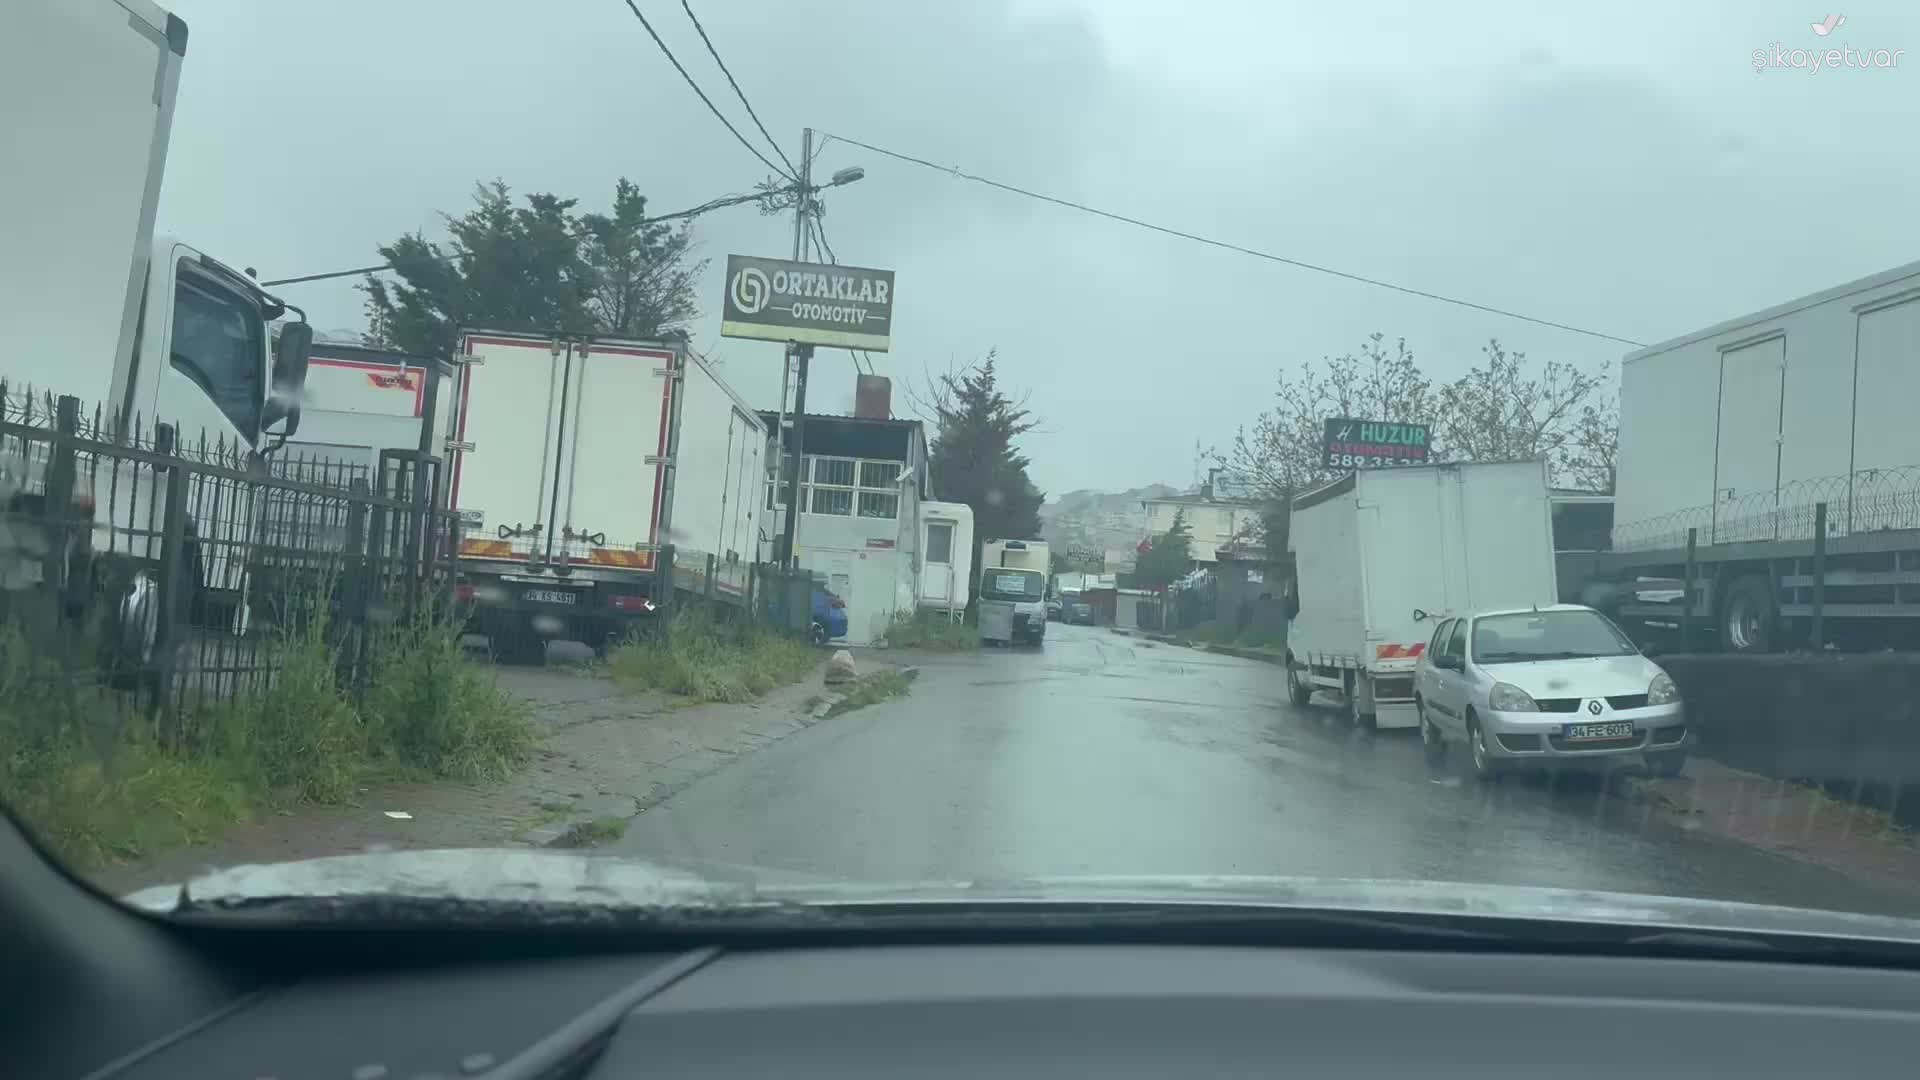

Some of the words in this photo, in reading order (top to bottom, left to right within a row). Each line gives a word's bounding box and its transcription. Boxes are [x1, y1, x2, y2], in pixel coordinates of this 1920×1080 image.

[772, 270, 889, 304] ORTAKLAR
[791, 302, 868, 325] OTOMOTİV
[1360, 423, 1425, 446] HUZUR
[1571, 726, 1585, 737] 34
[1586, 725, 1604, 737] FE
